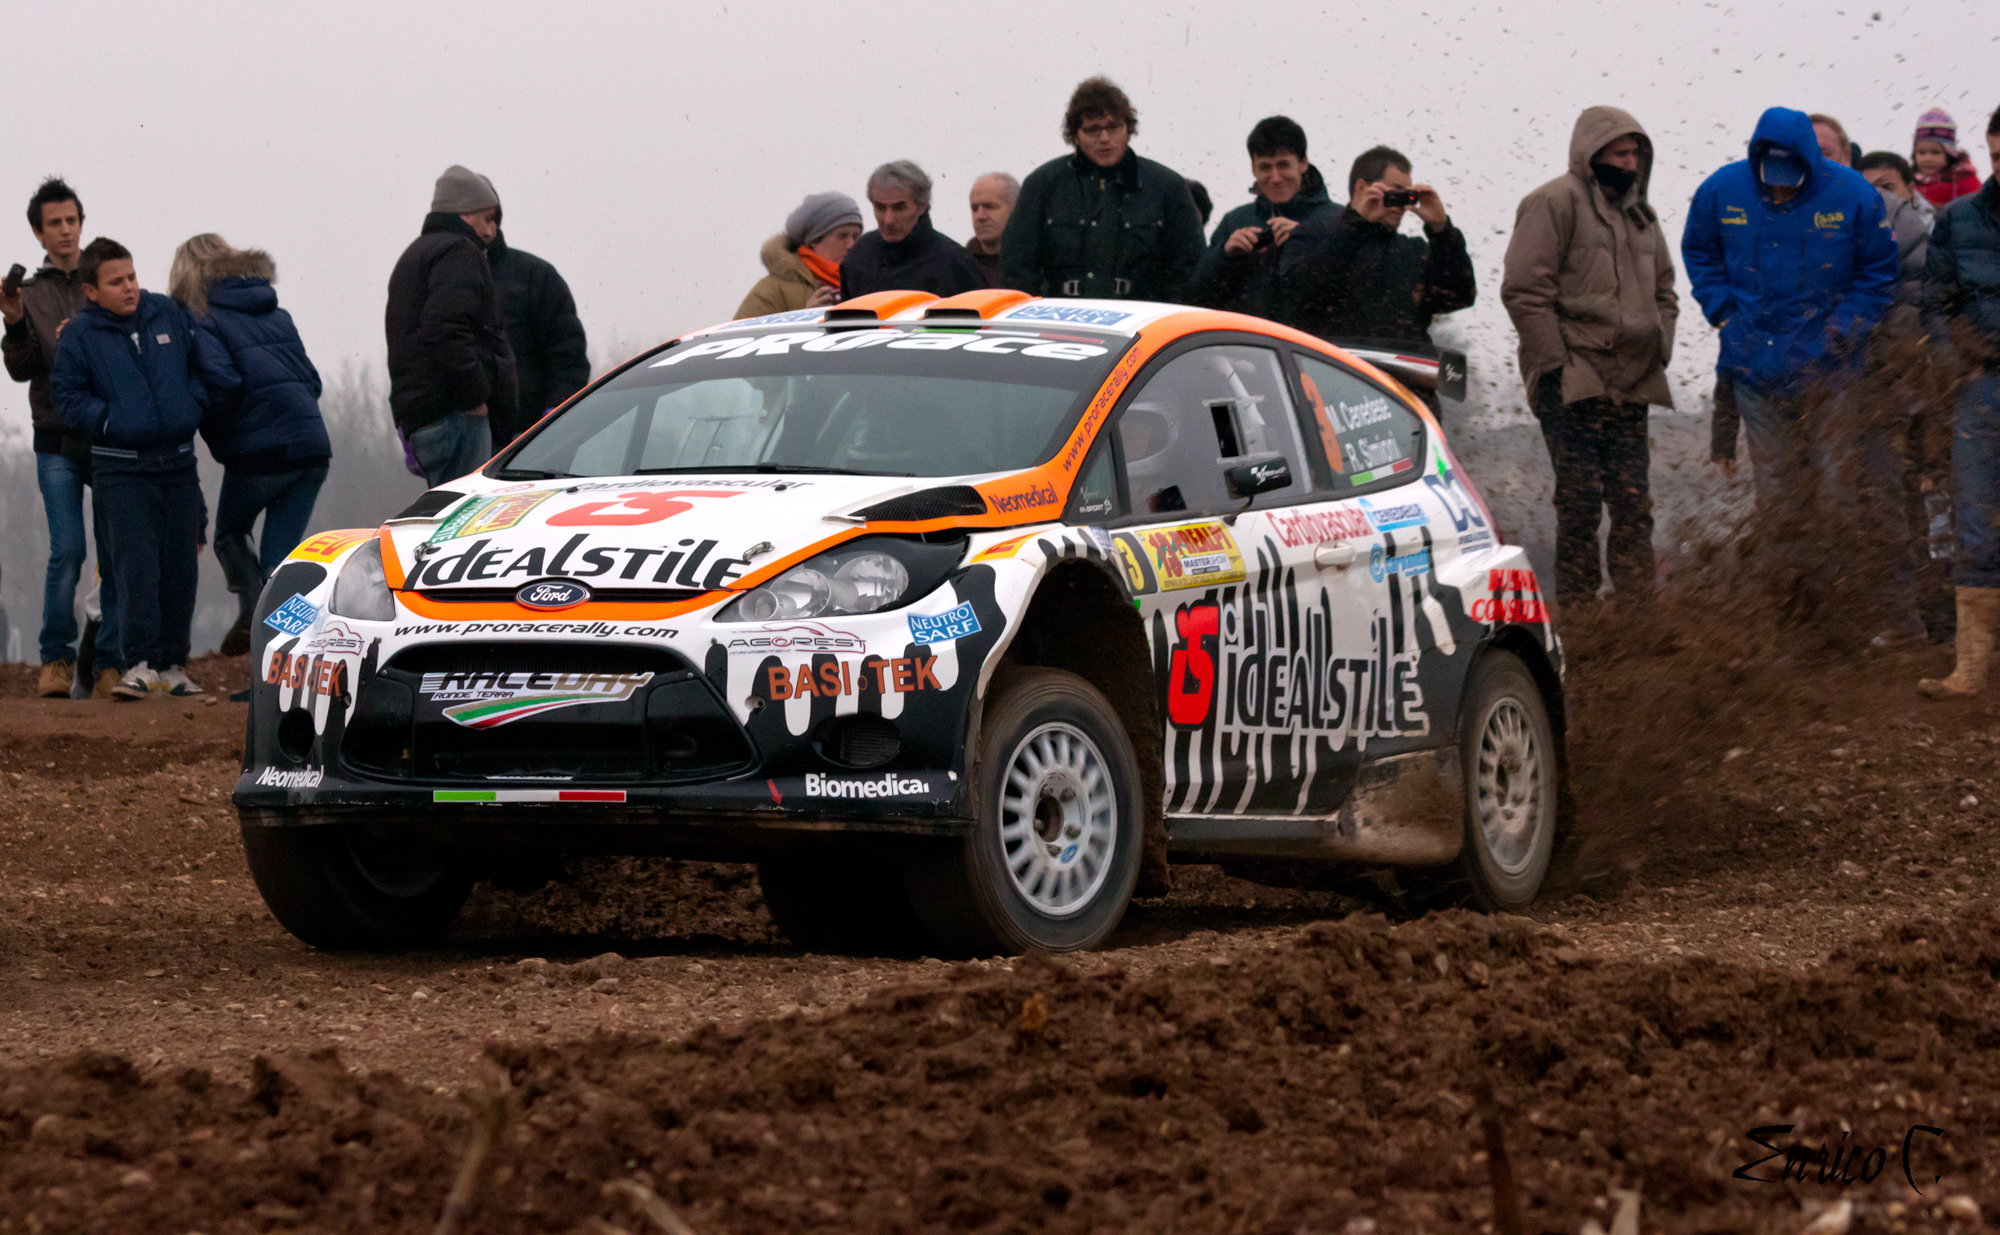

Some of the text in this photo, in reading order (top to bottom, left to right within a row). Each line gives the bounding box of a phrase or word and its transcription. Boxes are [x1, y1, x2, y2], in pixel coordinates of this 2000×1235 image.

[1063, 347, 1142, 472] www.proracerally.com
[987, 480, 1060, 515] Neomedical
[1113, 536, 1145, 591] 3
[530, 582, 571, 603] Ford
[394, 620, 679, 640] www.proracerally.com
[911, 606, 969, 630] NEUTRO
[728, 636, 867, 649] AGOREST
[914, 618, 974, 644] SARF
[434, 691, 515, 699] RONDE TERRA
[439, 672, 654, 699] RACEDAY
[255, 764, 325, 789] Neomedical
